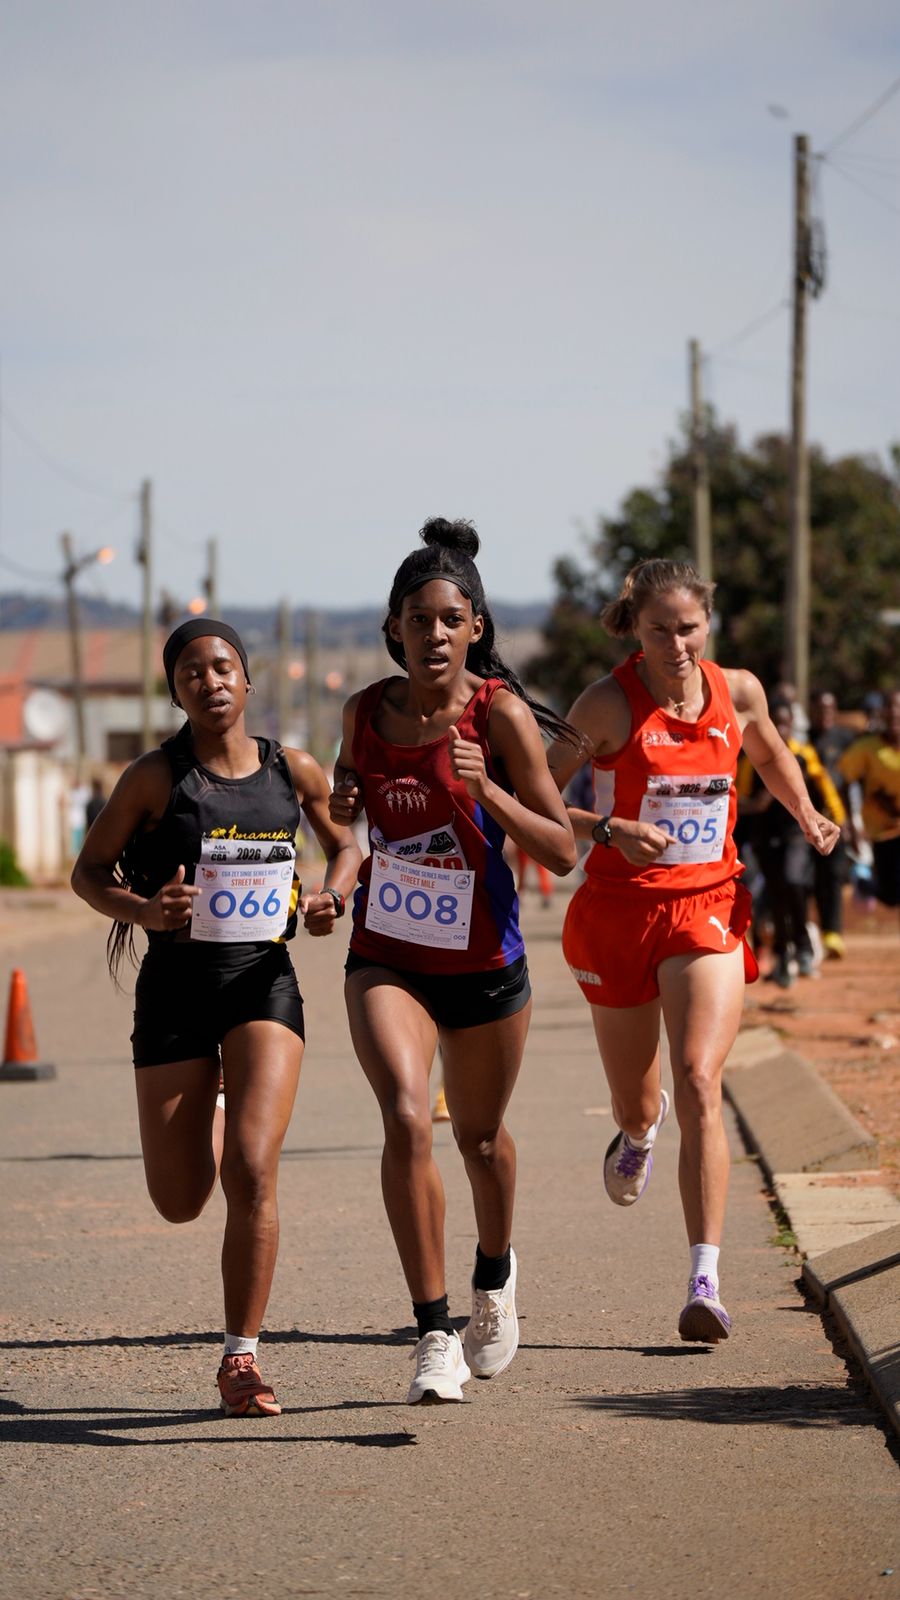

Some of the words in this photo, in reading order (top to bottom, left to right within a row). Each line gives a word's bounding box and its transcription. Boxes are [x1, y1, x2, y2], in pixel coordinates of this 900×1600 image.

[678, 783, 701, 794] 2026
[710, 780, 728, 790] ASA
[432, 834, 451, 847] ASA
[236, 847, 261, 860] 2026
[271, 848, 290, 857] ASA
[396, 842, 422, 856] 2026
[252, 878, 266, 886] MILE
[400, 874, 420, 886] STREET
[421, 879, 436, 889] MILE
[209, 888, 280, 919] 066
[378, 882, 458, 926] 008
[569, 964, 602, 986] OXER
